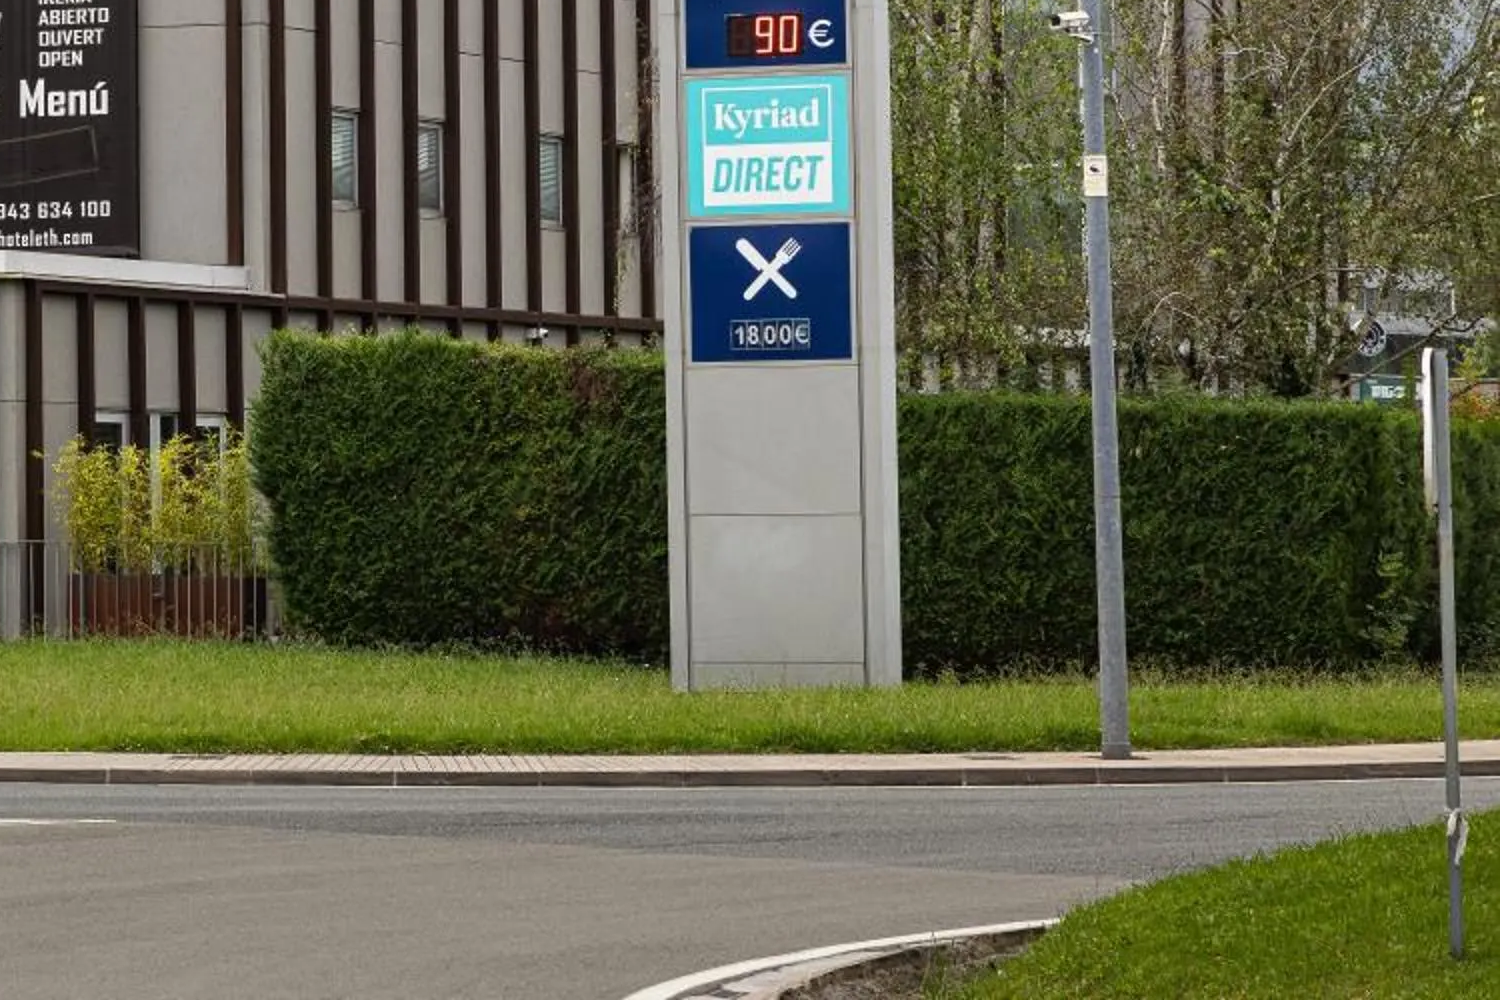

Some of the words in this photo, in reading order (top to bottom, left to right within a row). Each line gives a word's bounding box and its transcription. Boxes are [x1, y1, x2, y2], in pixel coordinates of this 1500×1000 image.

[38, 7, 109, 26] ABIERTO
[38, 28, 104, 47] OUVERT
[755, 15, 798, 54] 90
[808, 19, 835, 47] €
[38, 50, 83, 67] OPEN
[19, 78, 109, 118] Menú
[713, 97, 819, 138] Kyriad
[712, 155, 824, 192] DIRECT
[37, 201, 73, 219] 634
[80, 200, 111, 217] 100
